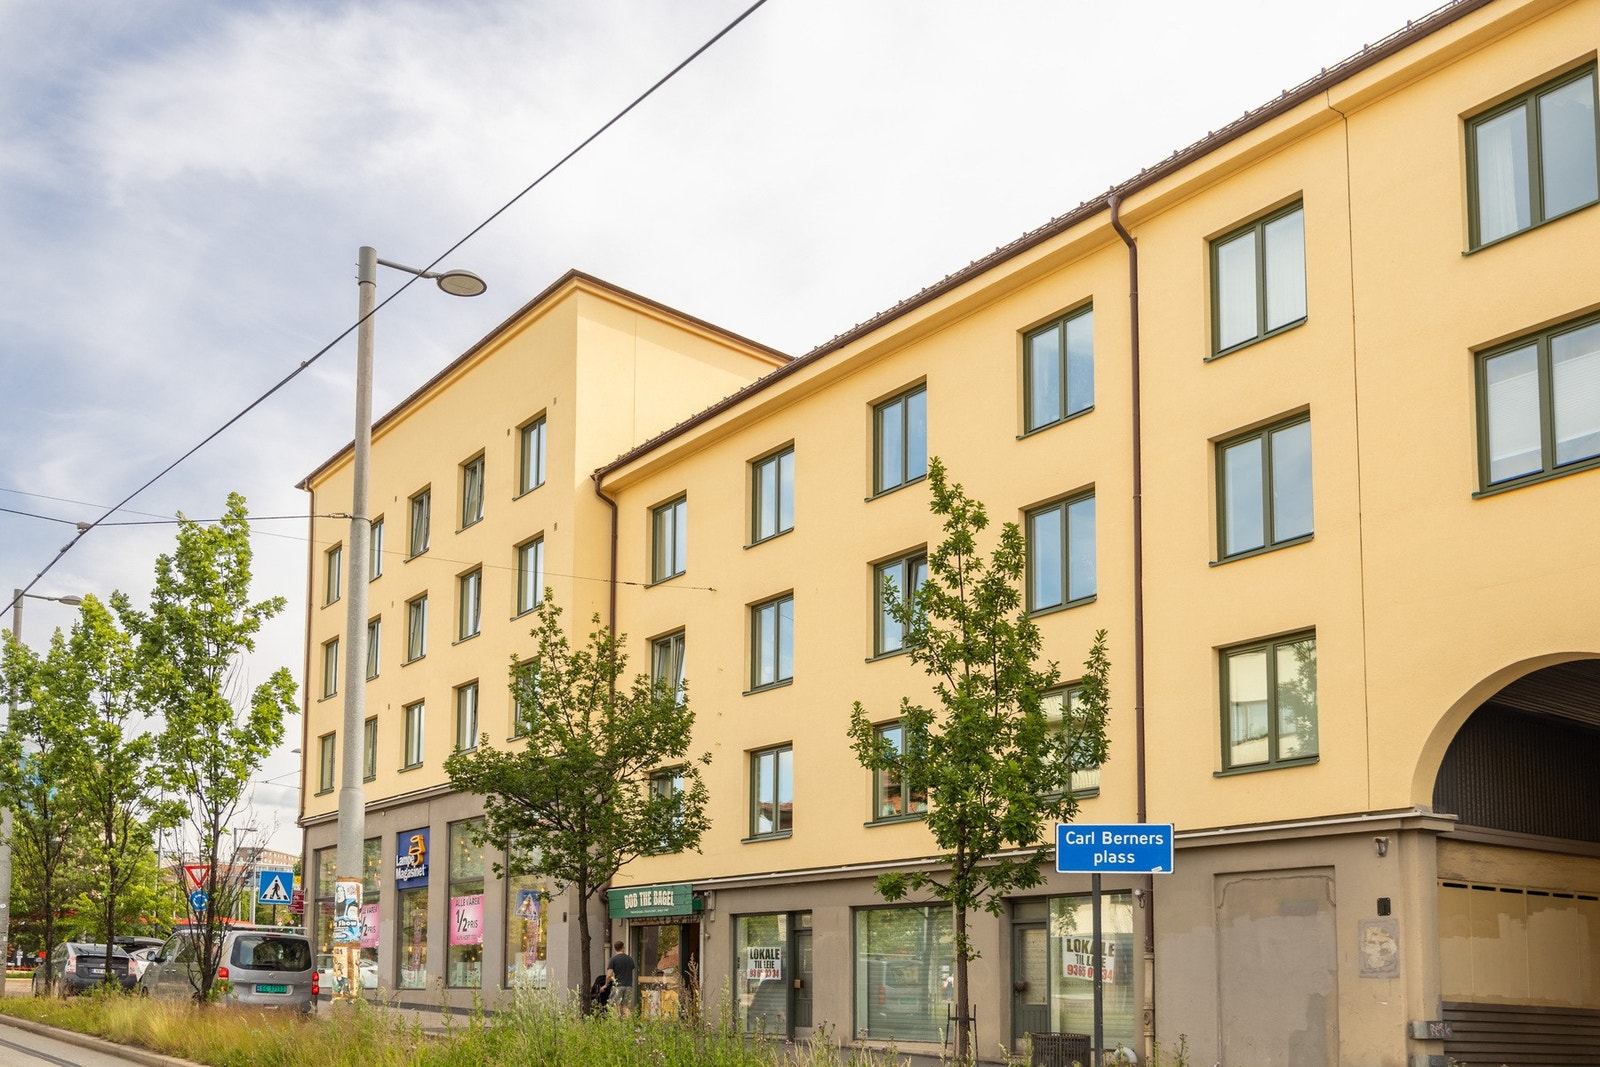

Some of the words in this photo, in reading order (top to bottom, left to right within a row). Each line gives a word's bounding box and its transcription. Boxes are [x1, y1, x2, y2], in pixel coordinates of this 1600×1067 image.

[1065, 830, 1095, 845] Carl
[1102, 831, 1164, 845] Berners
[396, 854, 415, 867] Lampe
[1093, 849, 1136, 867] plass
[395, 864, 427, 881] Magasinet
[624, 892, 638, 909] BOB
[639, 891, 652, 907] THE
[653, 890, 675, 907] BAGEL
[467, 919, 479, 929] PRIS
[749, 948, 780, 960] LOKALE
[1066, 938, 1115, 957] LOKLE
[754, 960, 762, 969] TIL
[763, 960, 775, 969] LEIE
[1075, 954, 1085, 966] TIL
